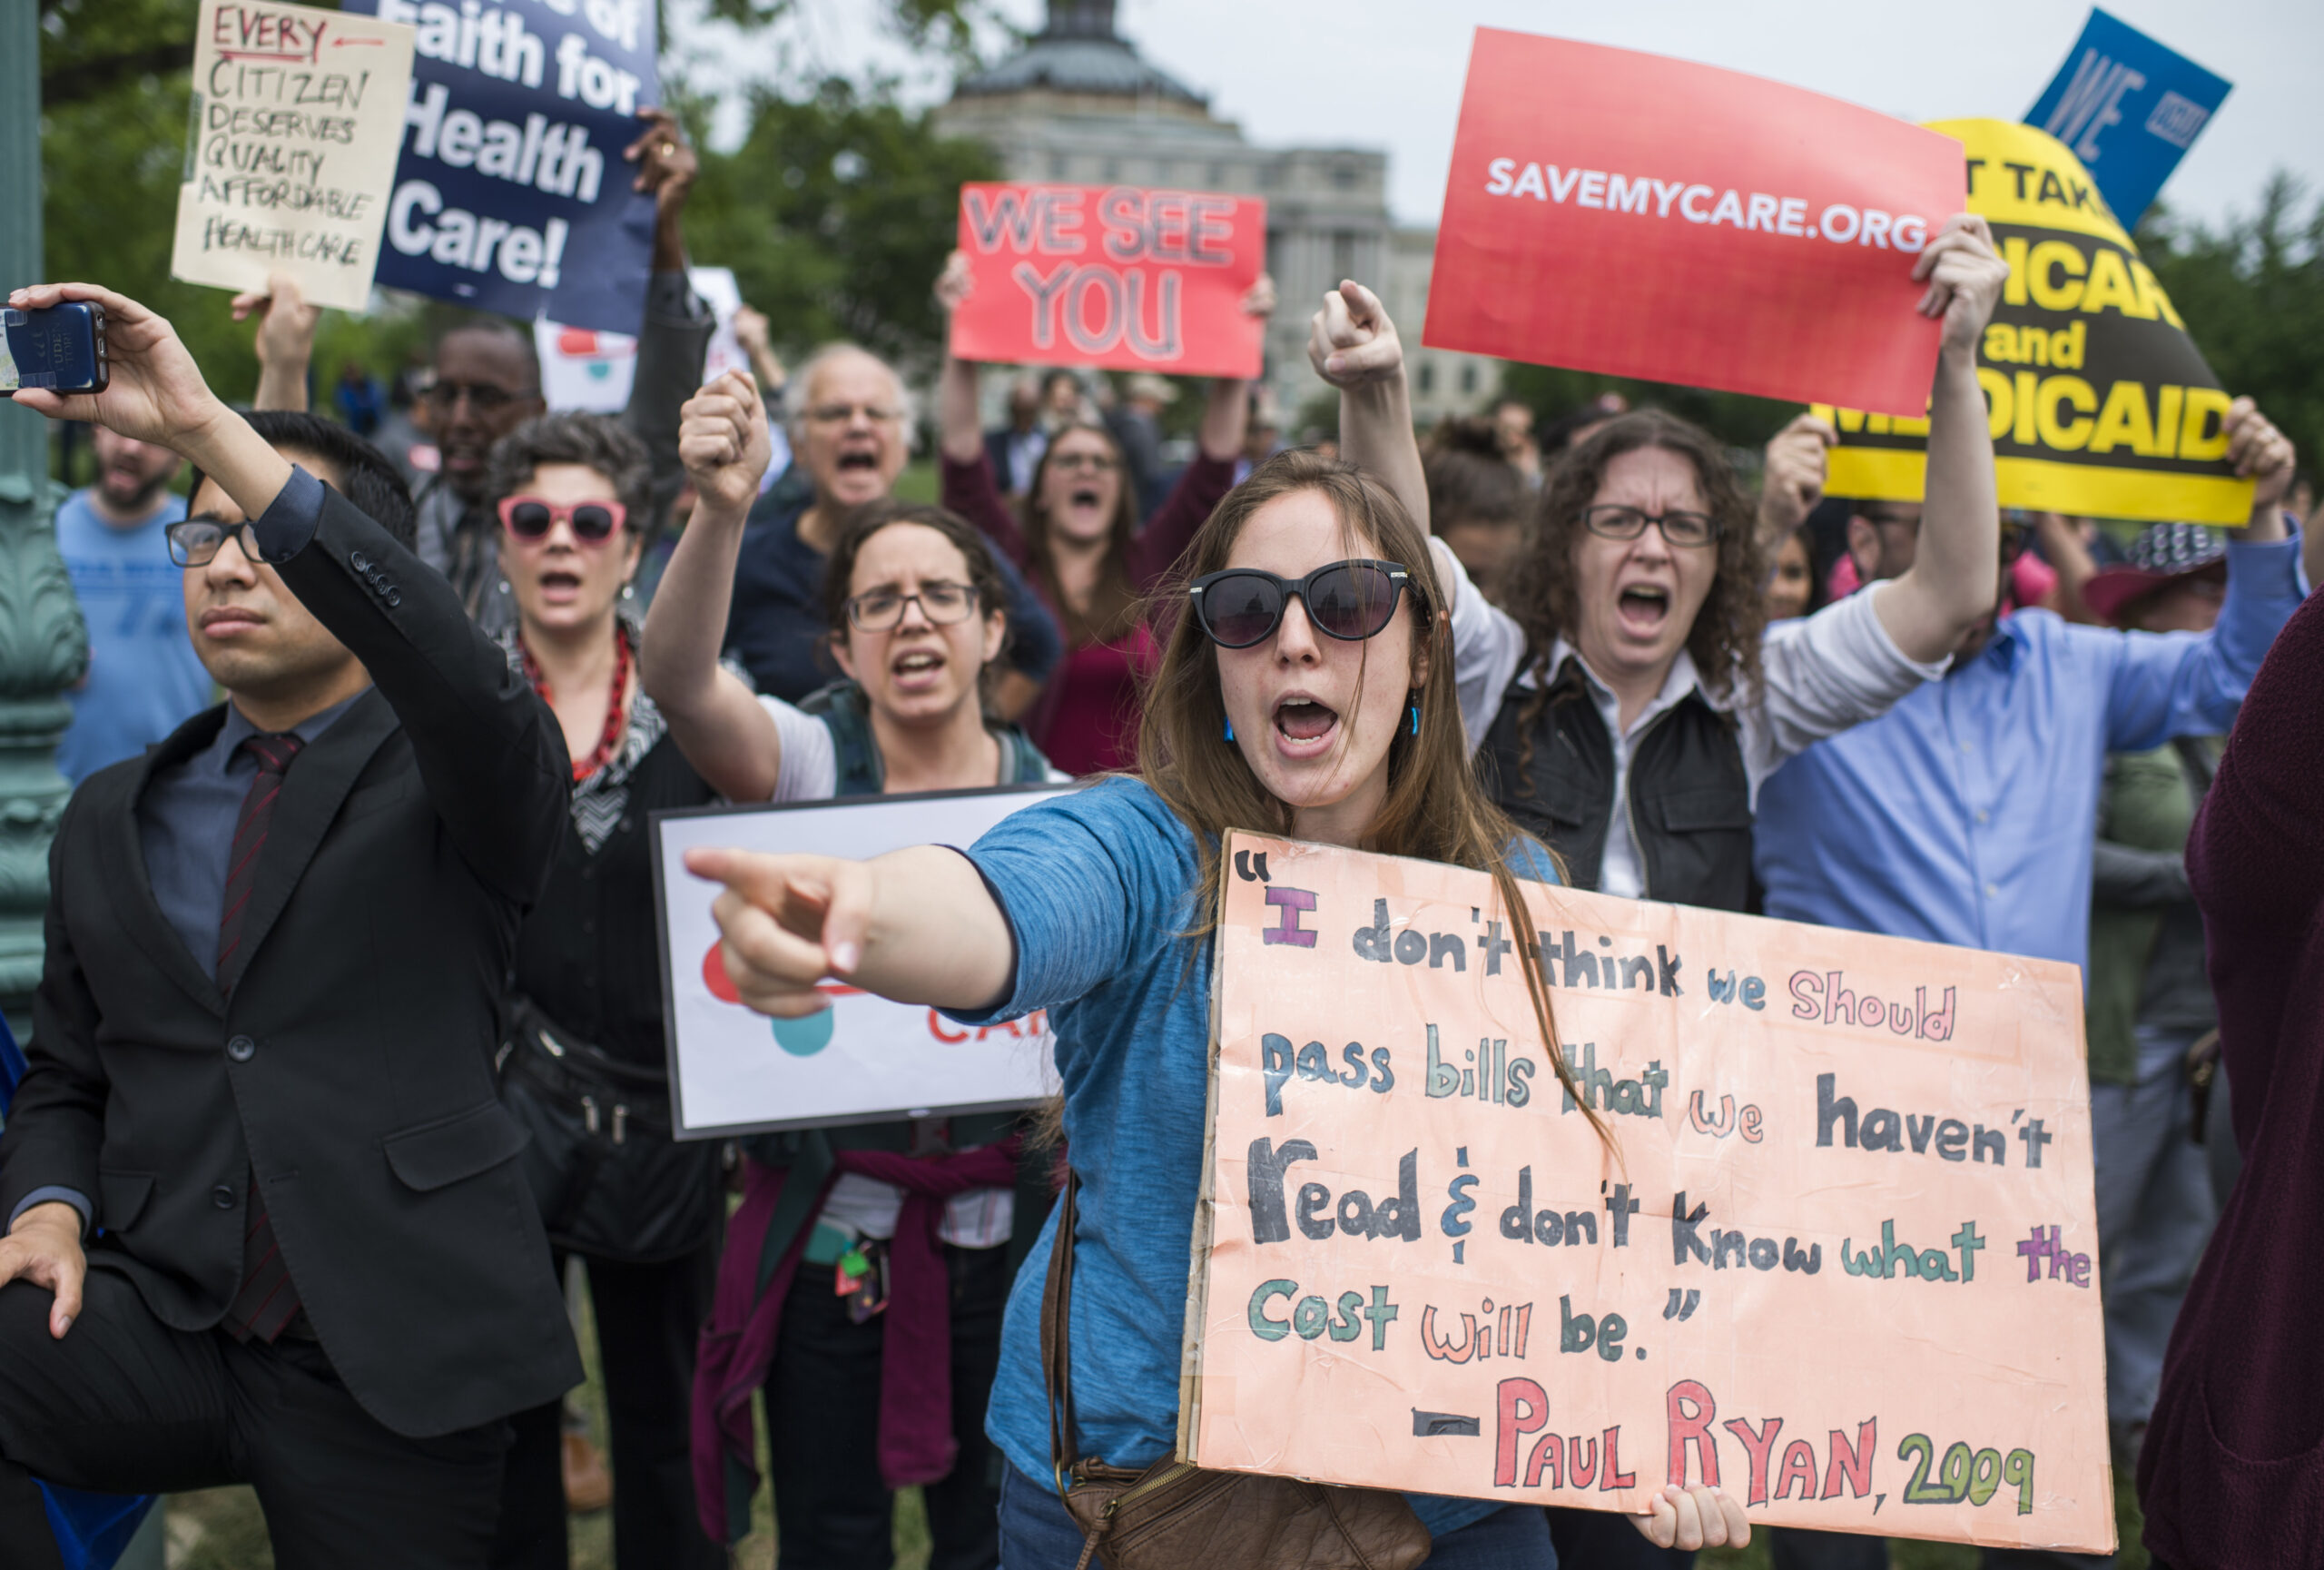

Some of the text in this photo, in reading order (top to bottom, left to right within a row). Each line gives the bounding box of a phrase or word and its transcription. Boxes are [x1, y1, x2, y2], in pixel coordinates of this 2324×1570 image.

[213, 5, 328, 64] EVERY
[556, 32, 641, 118] for
[209, 57, 370, 112] CITIZEN
[209, 102, 358, 145] DESERVES
[202, 133, 327, 186] QUALITY
[405, 76, 605, 204] Health
[198, 173, 375, 221] AFFORDABLE
[387, 179, 570, 290] Care!
[962, 184, 1238, 269] WE SEE
[1485, 156, 1928, 254] SAVEMYCARE.ORG
[2003, 162, 2106, 221] TAK
[1010, 260, 1185, 363] YOU
[1983, 320, 2087, 370] and
[1352, 897, 1512, 977] don't
[1529, 929, 1685, 997] think
[1707, 968, 1767, 1012] we
[1261, 1032, 1395, 1118] pass
[1424, 1022, 1536, 1109] bills
[1554, 1042, 1669, 1119] that
[1816, 1071, 2053, 1169] haven't
[1440, 1145, 1481, 1265] &
[1499, 1164, 1640, 1249] don't
[1840, 1218, 1986, 1285] what
[2016, 1223, 2092, 1289] the
[1492, 1375, 1637, 1492] PAUL
[1665, 1377, 1888, 1516] RYAN,
[1898, 1433, 2035, 1516] 2009
